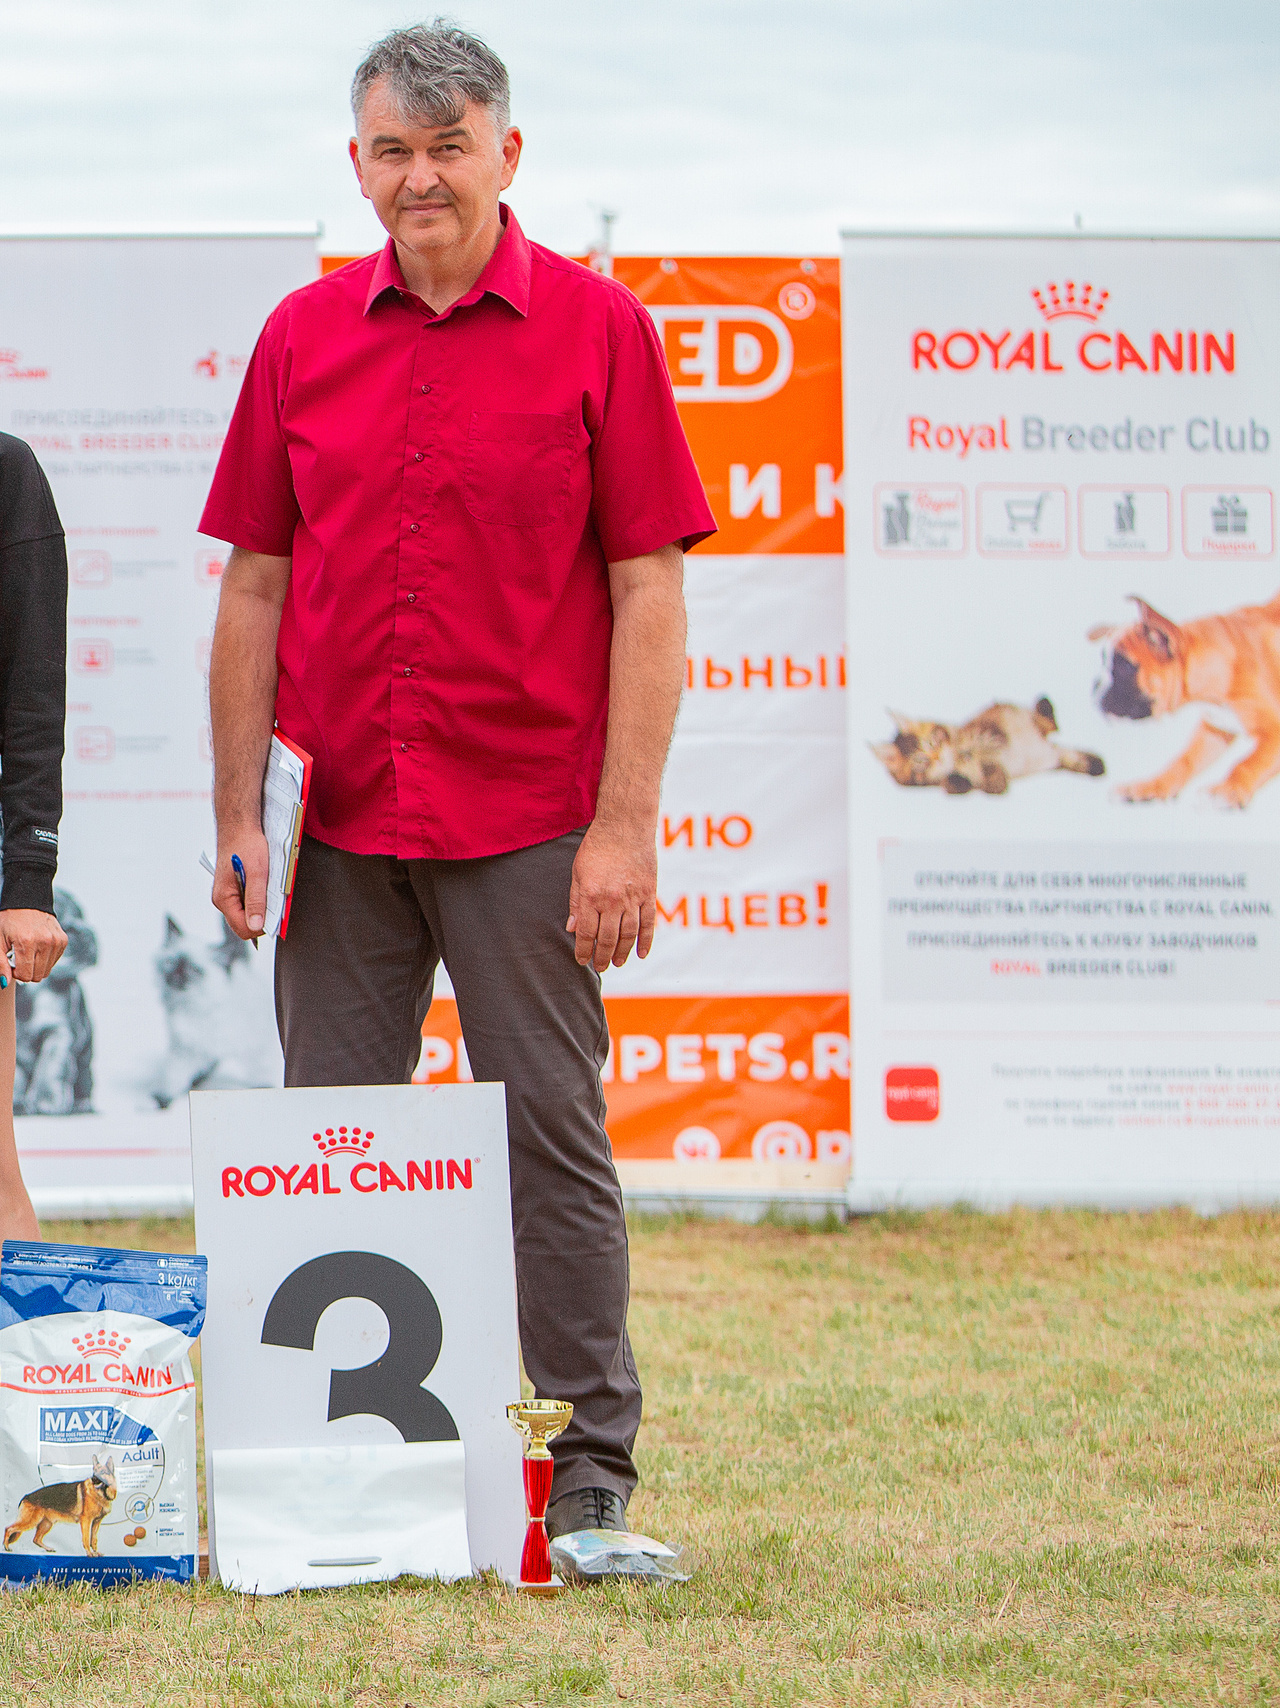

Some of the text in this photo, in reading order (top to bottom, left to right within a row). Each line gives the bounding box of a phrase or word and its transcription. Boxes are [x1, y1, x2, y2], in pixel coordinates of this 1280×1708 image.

[657, 314, 782, 392] ED
[909, 330, 1236, 373] ROYAL CANIN
[907, 415, 1271, 457] Royal Breeder Club
[729, 463, 845, 519] И К
[663, 814, 752, 848] ИЮ
[656, 883, 829, 934] МЦЕВ!
[221, 1158, 473, 1198] ROYAL CANIN
[157, 1272, 165, 1285] 3
[261, 1250, 461, 1444] 3
[23, 1363, 173, 1388] ROYAL CANIN
[44, 1410, 109, 1432] MAXI
[122, 1447, 159, 1463] Adult
